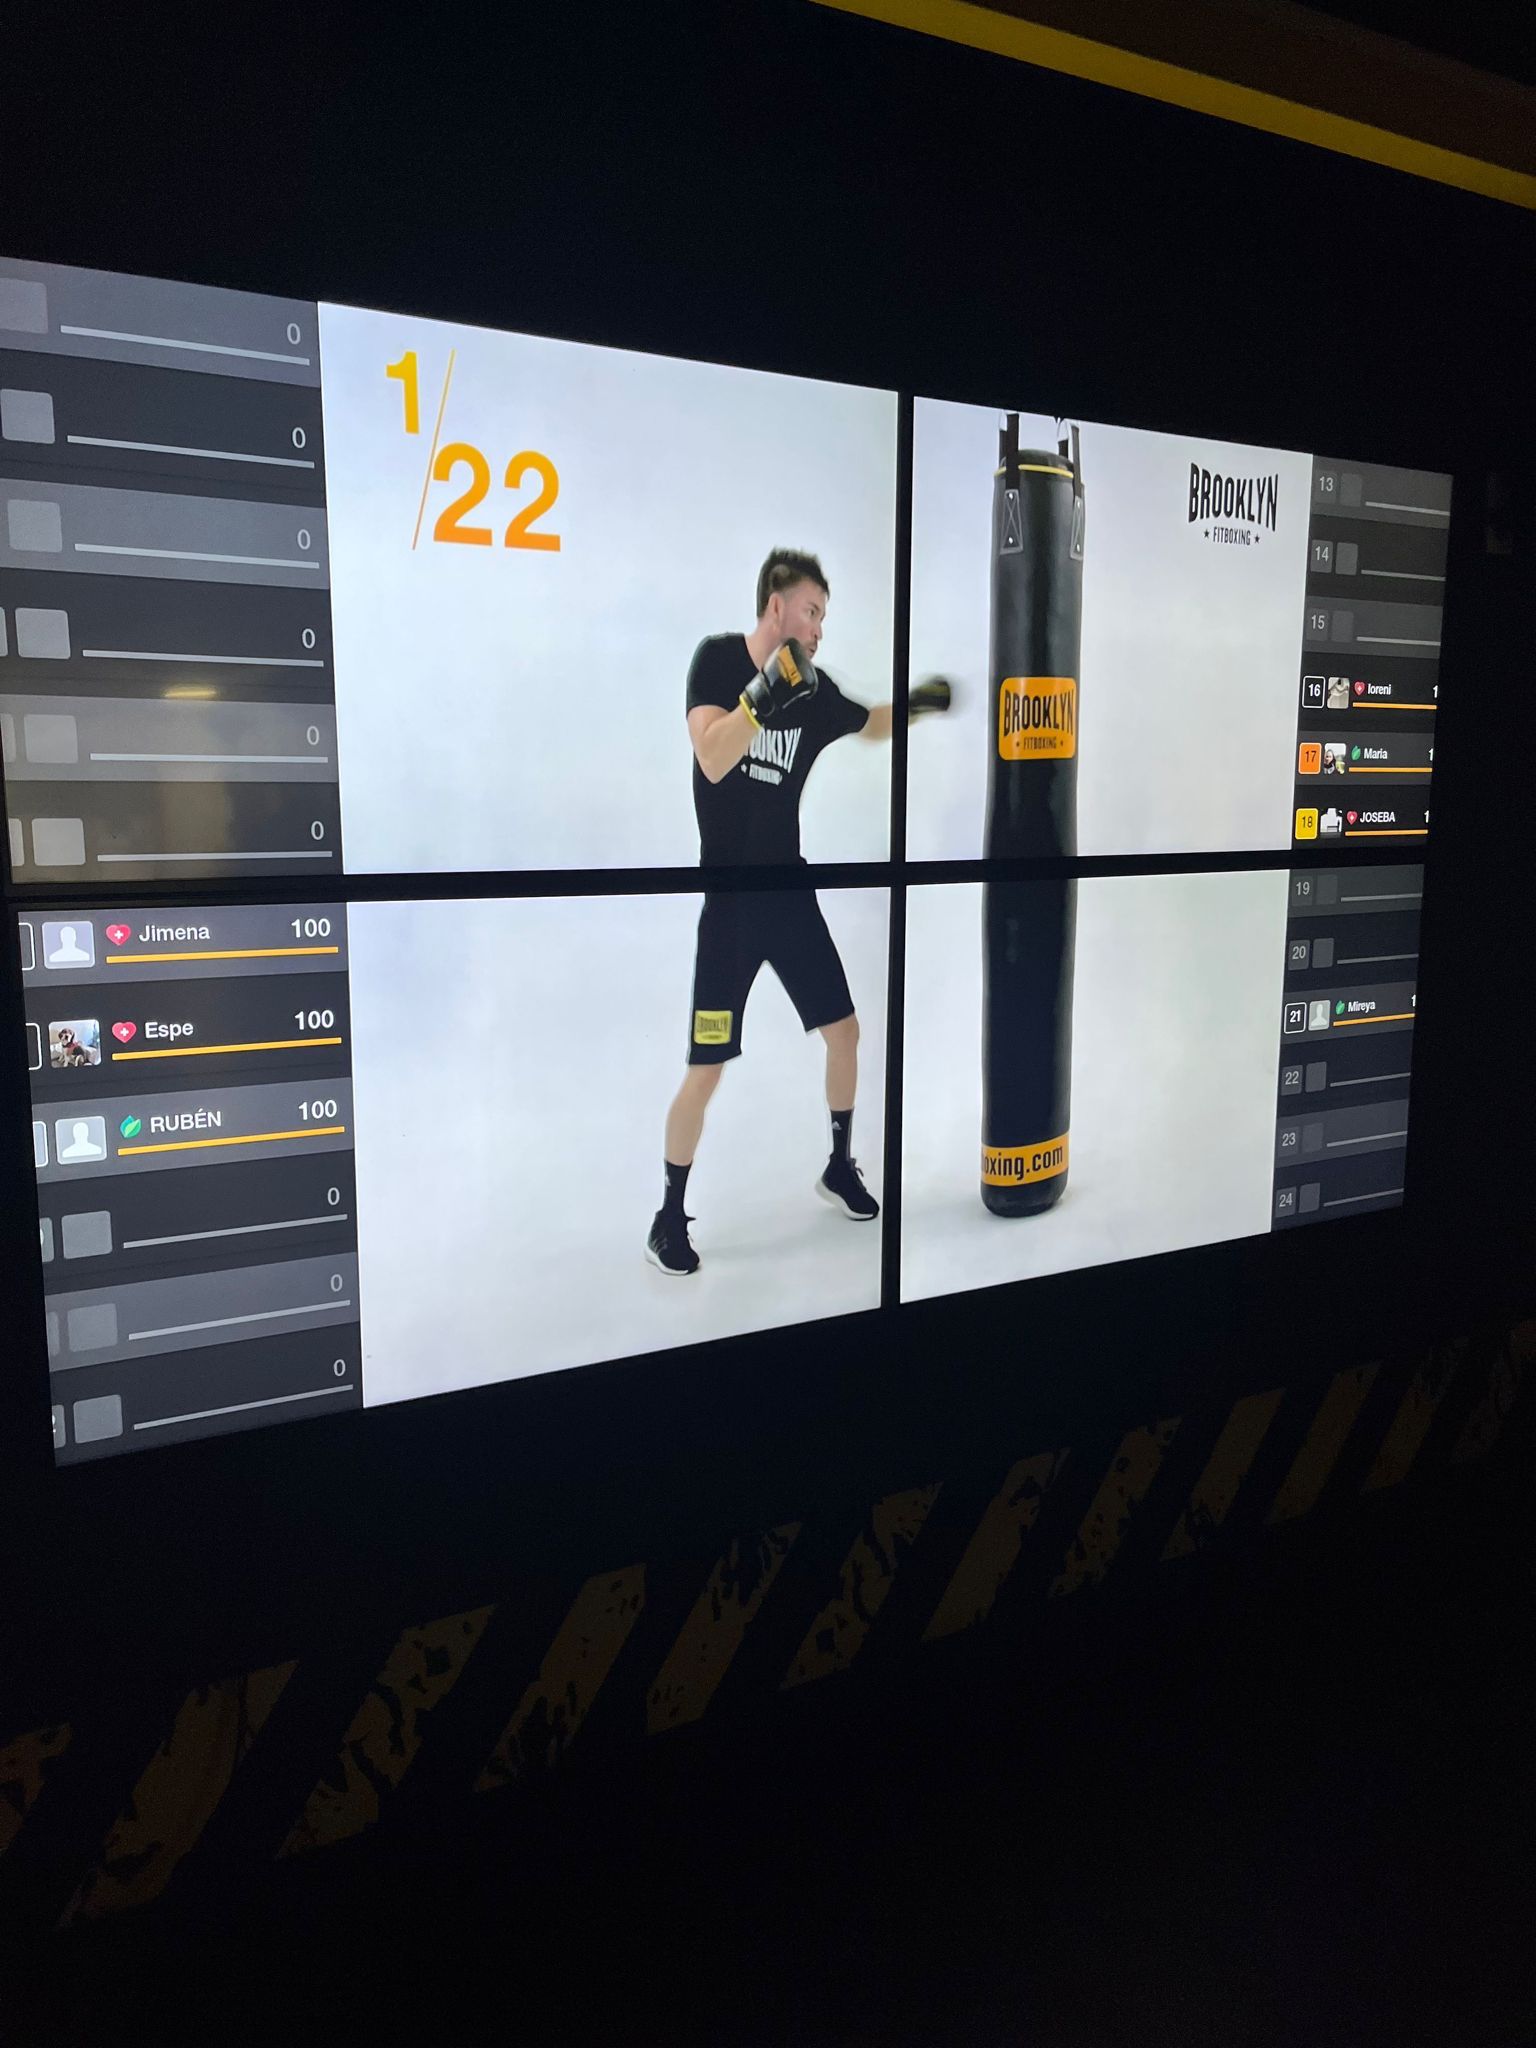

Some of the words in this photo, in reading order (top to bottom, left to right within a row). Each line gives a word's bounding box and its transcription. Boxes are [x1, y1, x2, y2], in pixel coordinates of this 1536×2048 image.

[287, 323, 301, 345] 0
[292, 427, 306, 449] 0
[1320, 476, 1333, 492] 13
[1188, 462, 1278, 532] BROOKLYN
[297, 529, 311, 551] 0
[1213, 526, 1251, 546] FITBOXING
[1315, 546, 1329, 562] 14
[1311, 614, 1325, 631] 15
[302, 628, 316, 650] 0
[1308, 683, 1321, 697] 16
[1004, 689, 1074, 737] BROOKLYN
[307, 725, 320, 746] 0
[1023, 736, 1057, 750] FITBOXING
[1305, 751, 1317, 763] 17
[1364, 748, 1388, 760] Maria
[1302, 816, 1313, 828] 18
[1359, 810, 1396, 823] JOSEBA
[311, 821, 324, 841] 0
[1296, 881, 1310, 896] 19
[139, 925, 210, 942] Jimena
[291, 918, 331, 938] 100
[1292, 946, 1306, 960] 20
[1289, 1009, 1301, 1023] 21
[1347, 1000, 1376, 1014] Mireya
[145, 1021, 194, 1041] Espe
[294, 1009, 334, 1030] 100
[1285, 1071, 1299, 1085] 22
[150, 1109, 222, 1134] RUBÉN
[298, 1099, 338, 1121] 100
[1282, 1132, 1296, 1147] 23
[327, 1187, 340, 1206] 0
[1279, 1193, 1293, 1208] 24
[330, 1274, 343, 1293] 0
[333, 1359, 345, 1378] 0
